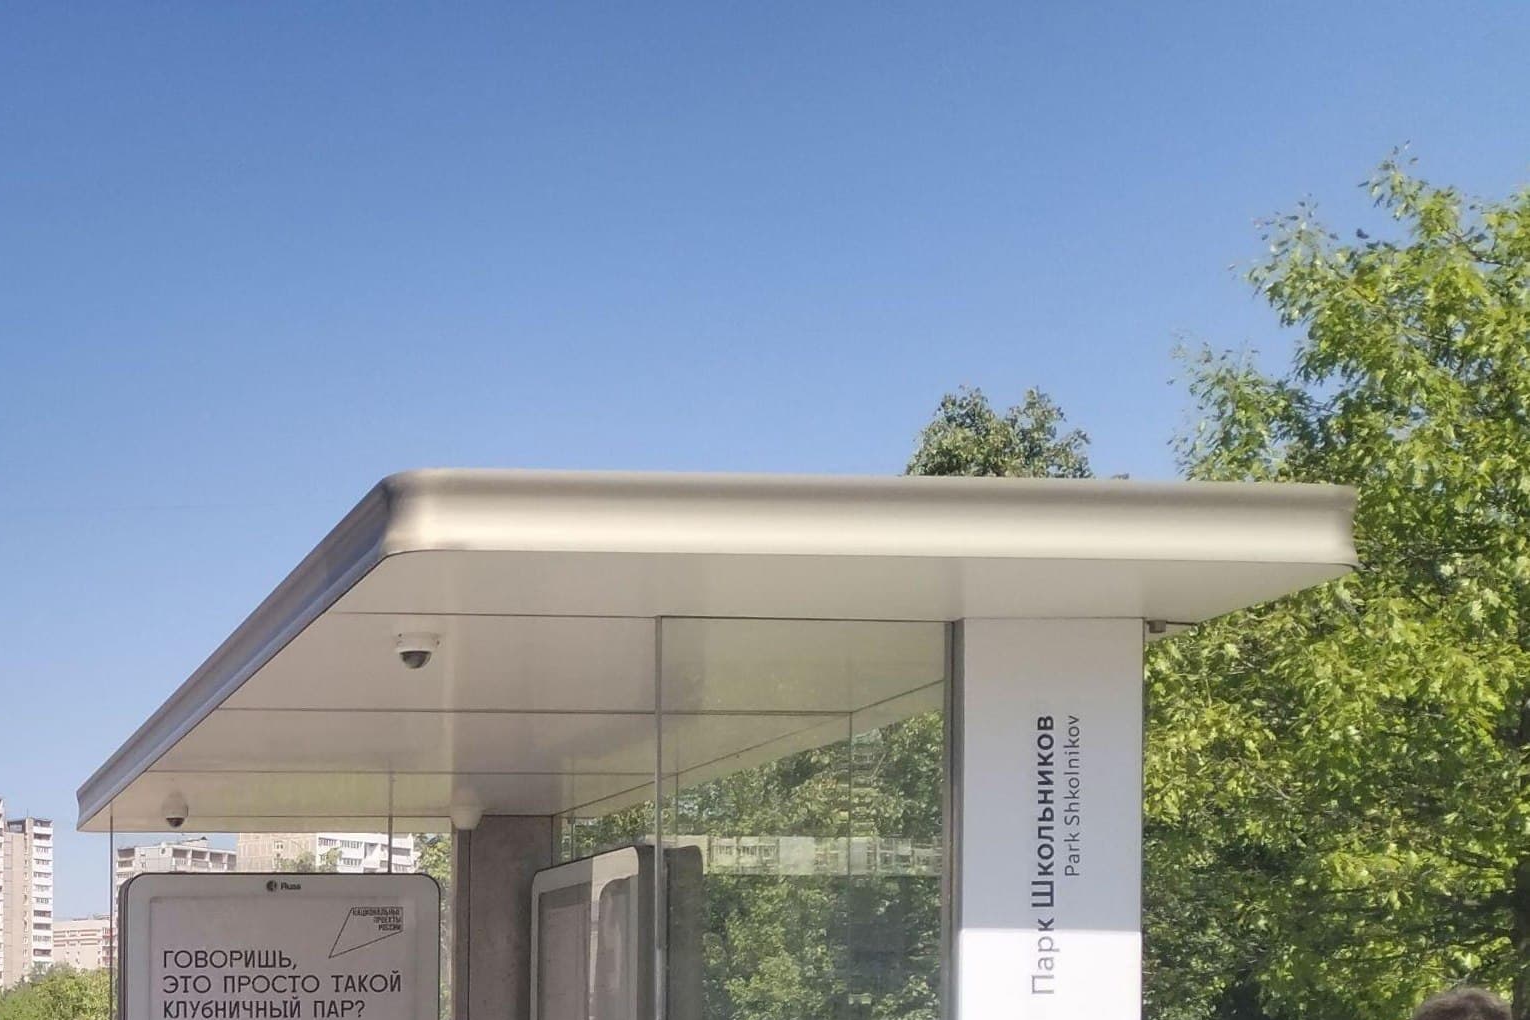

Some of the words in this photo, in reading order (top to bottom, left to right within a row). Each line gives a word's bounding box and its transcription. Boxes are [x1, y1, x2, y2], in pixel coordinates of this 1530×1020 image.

[1064, 715, 1081, 825] Shkolnikov
[1031, 715, 1055, 908] Школьников
[1064, 832, 1081, 876] Park
[163, 950, 297, 969] ГОВОРИШЬ,
[1031, 918, 1060, 995] Парк
[163, 974, 211, 994] ЭТО
[223, 974, 320, 994] ПРОСТО
[331, 970, 402, 993] ТАКОЙ
[313, 1000, 366, 1019] ПАР?
